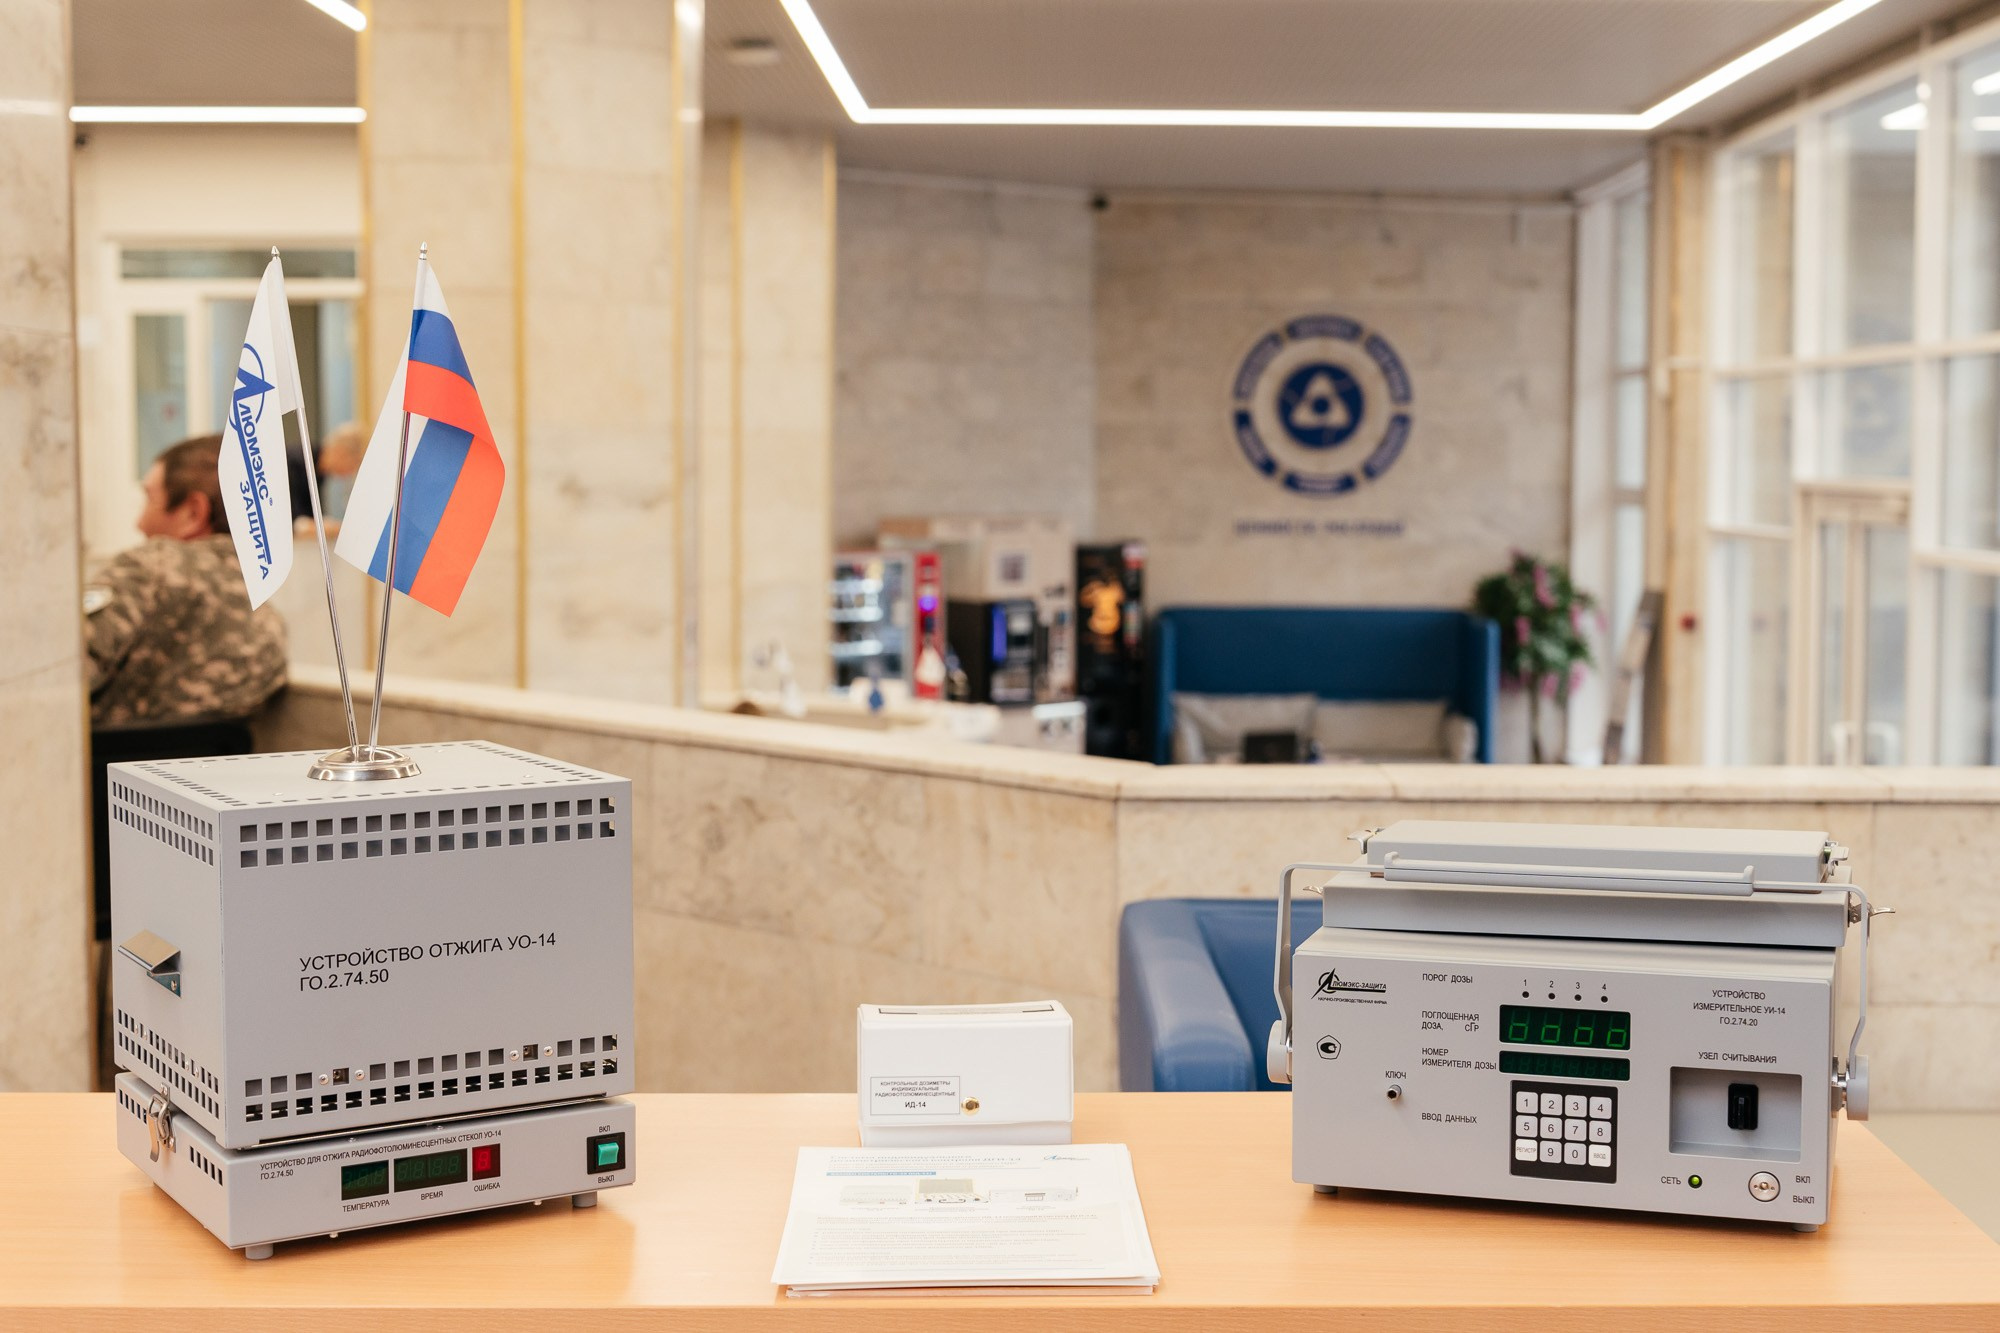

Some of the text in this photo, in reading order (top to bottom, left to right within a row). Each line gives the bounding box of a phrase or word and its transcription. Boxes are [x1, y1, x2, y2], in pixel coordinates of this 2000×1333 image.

[240, 480, 269, 580] ЗАЩИТА
[300, 932, 556, 972] УСТРОЙСТВО ОТЖИГА УО-14
[300, 969, 390, 992] ГО.2.74.50
[1422, 974, 1473, 984] ПОРОГ ДОЗЫ
[1712, 990, 1766, 1000] УСТРОЙСТВО
[1693, 1002, 1786, 1014] ИЗМЕРИТЕЛЬНОЕ УИ-14
[1422, 1010, 1480, 1022] ПОГЛОЩЕННАЯ
[1422, 1022, 1444, 1031] ДОЗА,
[1720, 1017, 1758, 1026] ГО.2.74.20
[1422, 1048, 1449, 1056] НОМЕР
[1698, 1052, 1776, 1063] УЗЕЛ СЧИТЫВАНИЯ
[1422, 1059, 1496, 1070] ИЗМЕРИТЕЛЯ ДОЗЫ
[1386, 1070, 1406, 1079] КЛЮЧ
[1524, 1098, 1604, 1112] 1 2 3 4
[1422, 1112, 1478, 1124] ВВОД ДАННЫХ
[1524, 1122, 1604, 1136] 5 6 7 8
[260, 1130, 502, 1170] УСТРОЙСТВО ДЛЯ ОТЖИГА РАДИОФОТОЛЮМИНЕСЦЕНТНЫХ СТЕКОЛ УО-14
[1548, 1148, 1554, 1157] 9
[1572, 1150, 1578, 1158] 0
[260, 1169, 294, 1180] ГО.2.74.50
[598, 1175, 614, 1184] ВЫКЛ
[1660, 1176, 1682, 1184] СЕТЬ
[1796, 1176, 1810, 1184] ВКЛ
[474, 1182, 500, 1192] ОШИБКА
[420, 1190, 444, 1200] ВРЕМЯ
[1792, 1196, 1814, 1204] ВЫКЛ
[342, 1198, 390, 1212] ТЕМПЕРАТУРА
